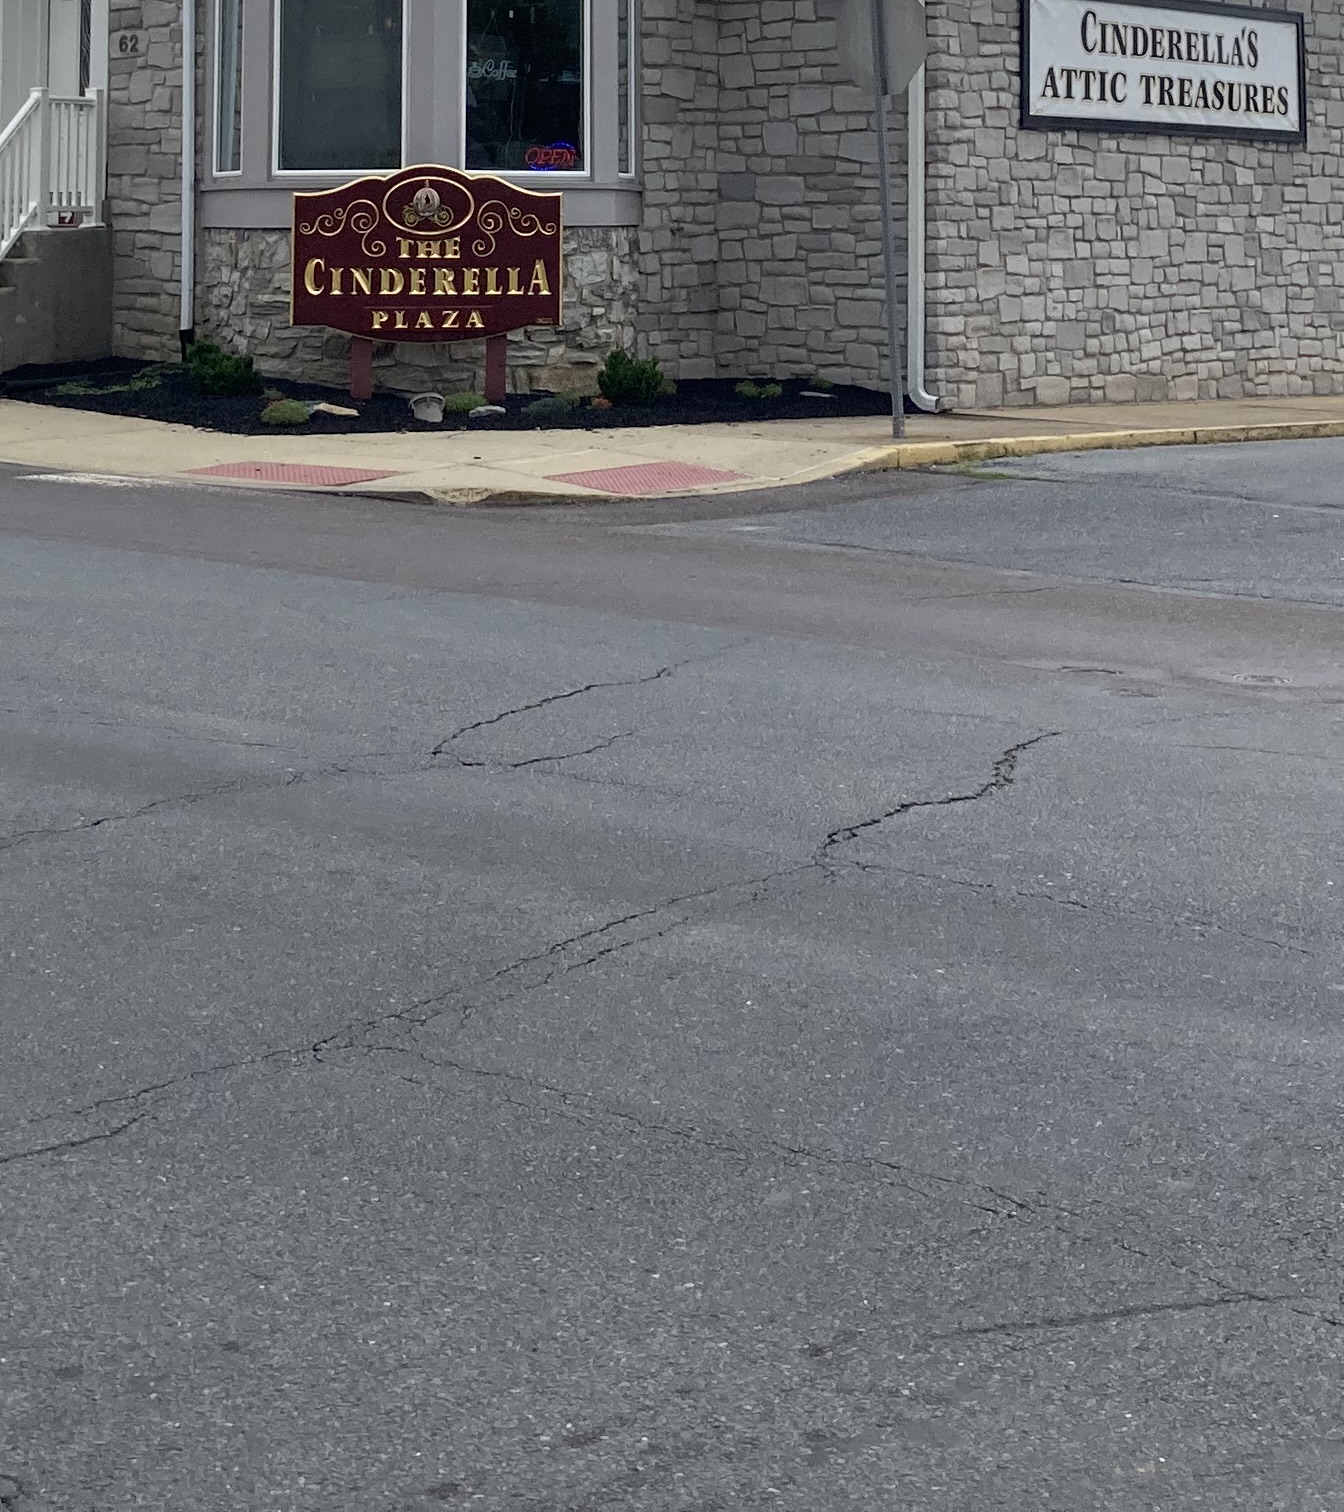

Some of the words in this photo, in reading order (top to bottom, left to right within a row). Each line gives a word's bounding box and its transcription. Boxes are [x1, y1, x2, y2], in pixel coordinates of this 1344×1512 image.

[119, 34, 139, 53] 62
[1081, 10, 1258, 69] CINDERELLA'S
[1041, 66, 1127, 104] ATTIC
[1140, 73, 1289, 116] TREASURES
[525, 147, 576, 166] OPEN
[396, 236, 461, 259] THE
[304, 257, 552, 296] CINDERELLA
[371, 310, 485, 329] PLAZA
